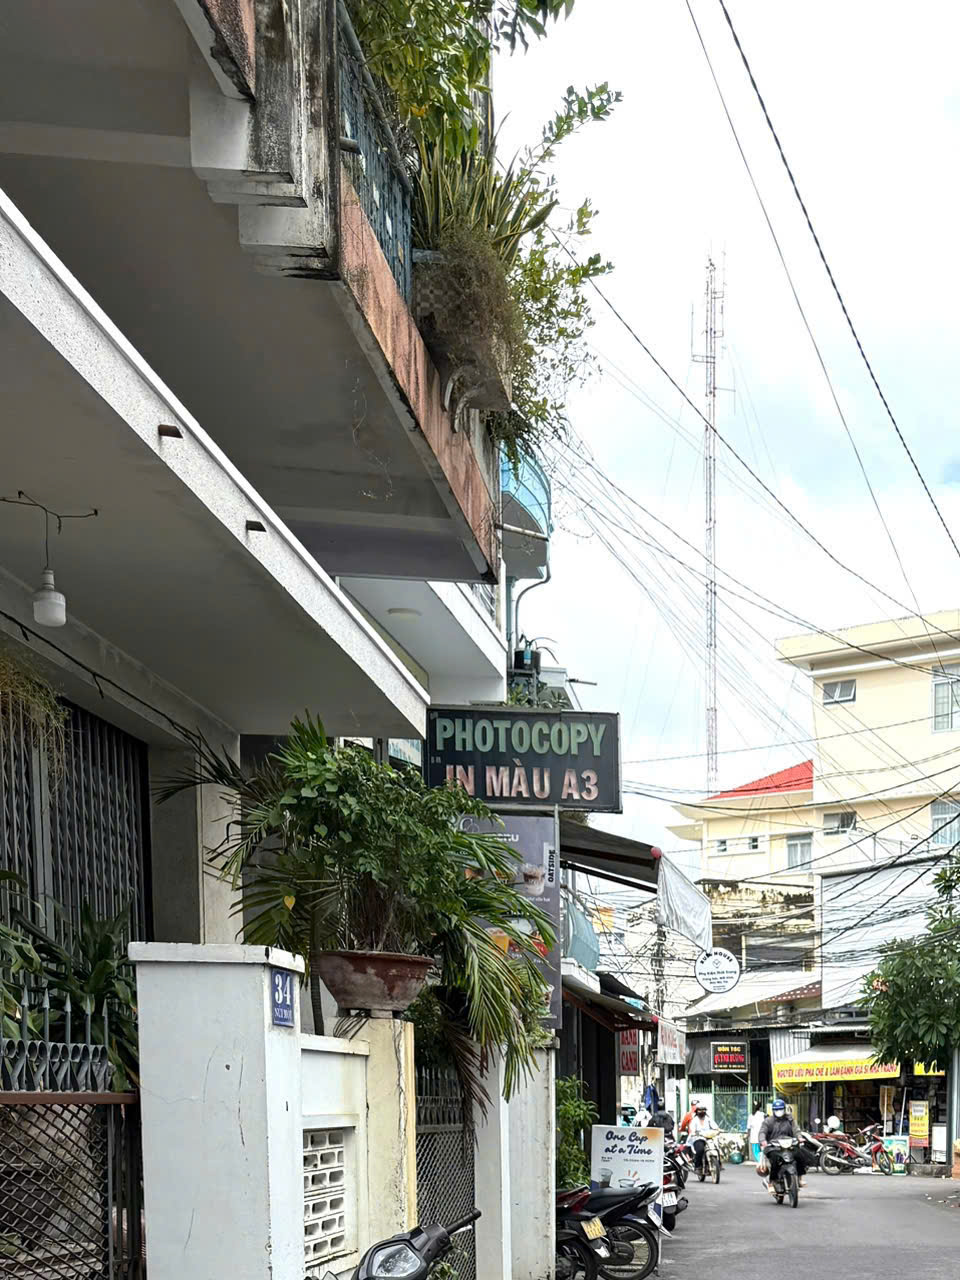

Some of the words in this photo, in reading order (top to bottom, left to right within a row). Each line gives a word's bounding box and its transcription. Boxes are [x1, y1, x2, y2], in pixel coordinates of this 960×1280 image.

[436, 717, 607, 757] PHOTOCOPY
[485, 758, 551, 799] MÀU
[561, 768, 599, 801] A3
[548, 849, 556, 883] OATSIDE
[275, 974, 291, 1006] 34
[605, 1143, 617, 1153] at
[627, 1144, 653, 1155] Time
[606, 1130, 626, 1142] One
[628, 1131, 648, 1144] Cup
